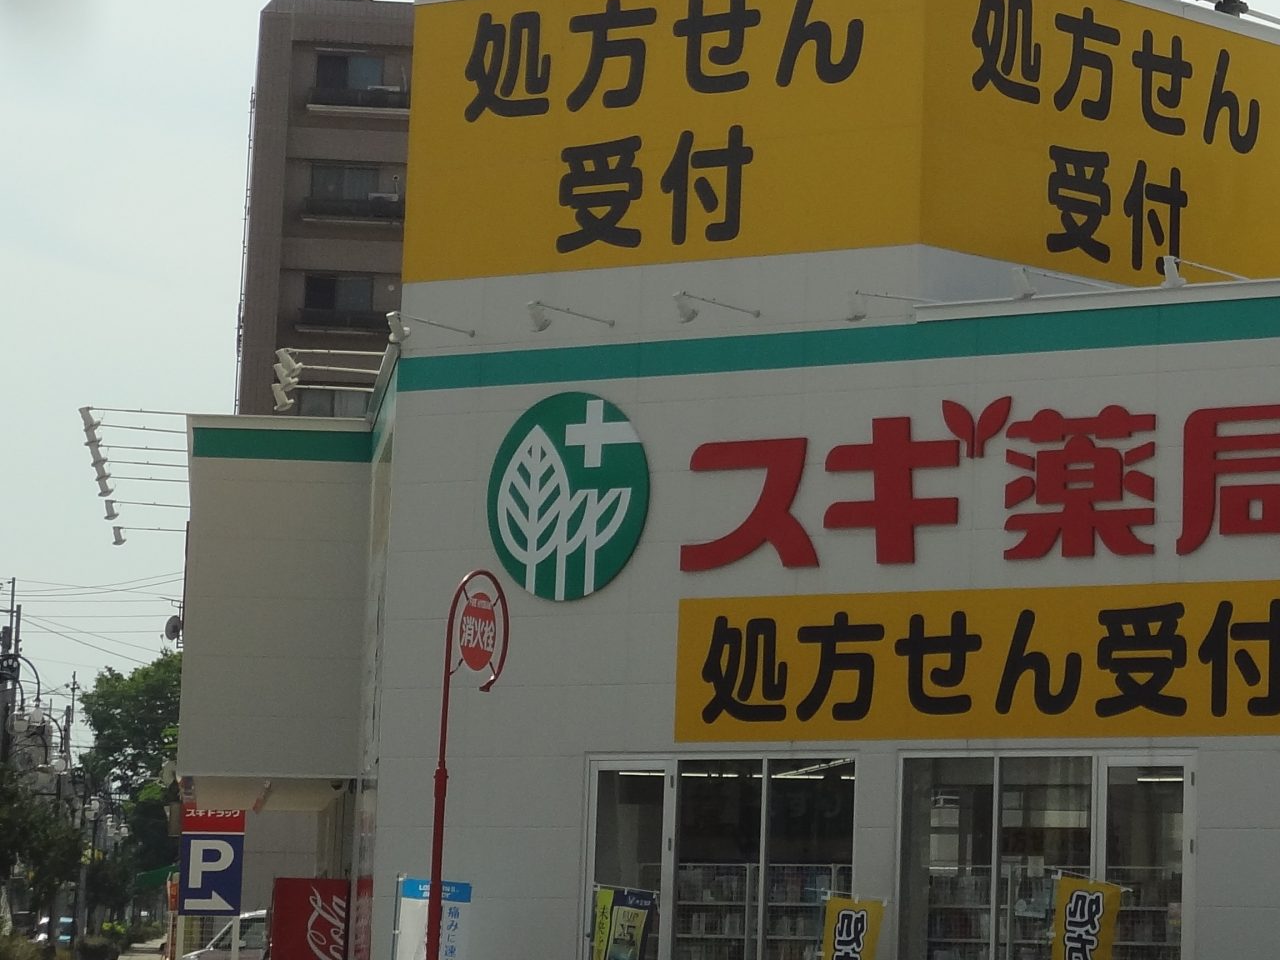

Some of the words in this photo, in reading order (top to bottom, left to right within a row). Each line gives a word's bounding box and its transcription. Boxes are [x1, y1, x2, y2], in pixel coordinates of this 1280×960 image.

[556, 125, 754, 254] 受付
[1046, 144, 1188, 275] 受付
[460, 616, 496, 653] 消火栓
[188, 839, 235, 889] P
